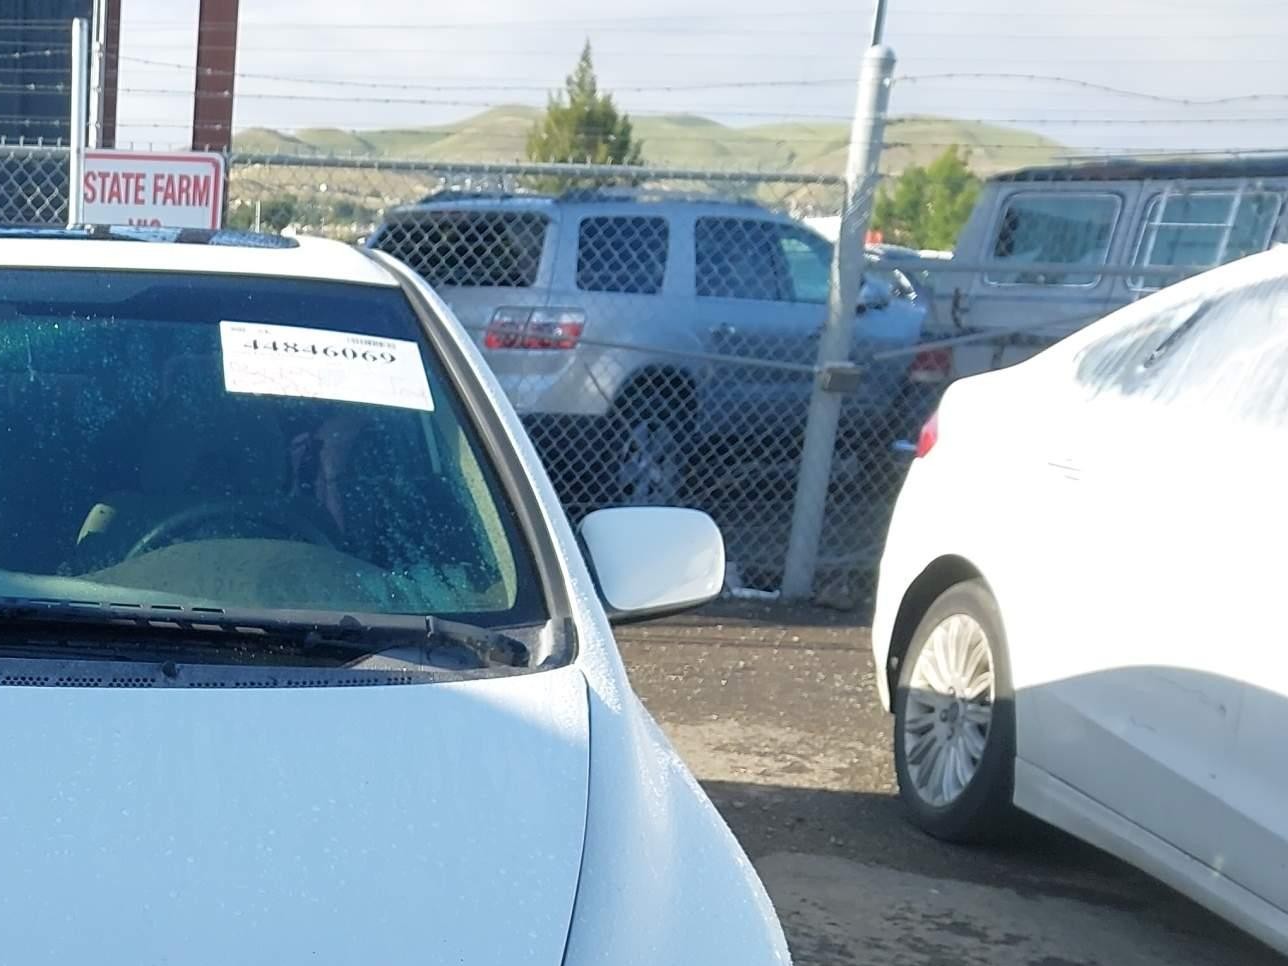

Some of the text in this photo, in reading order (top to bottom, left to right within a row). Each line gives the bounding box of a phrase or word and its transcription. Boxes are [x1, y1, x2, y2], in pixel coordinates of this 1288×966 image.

[84, 170, 211, 207] STATE FARM
[242, 338, 397, 364] 44846069
